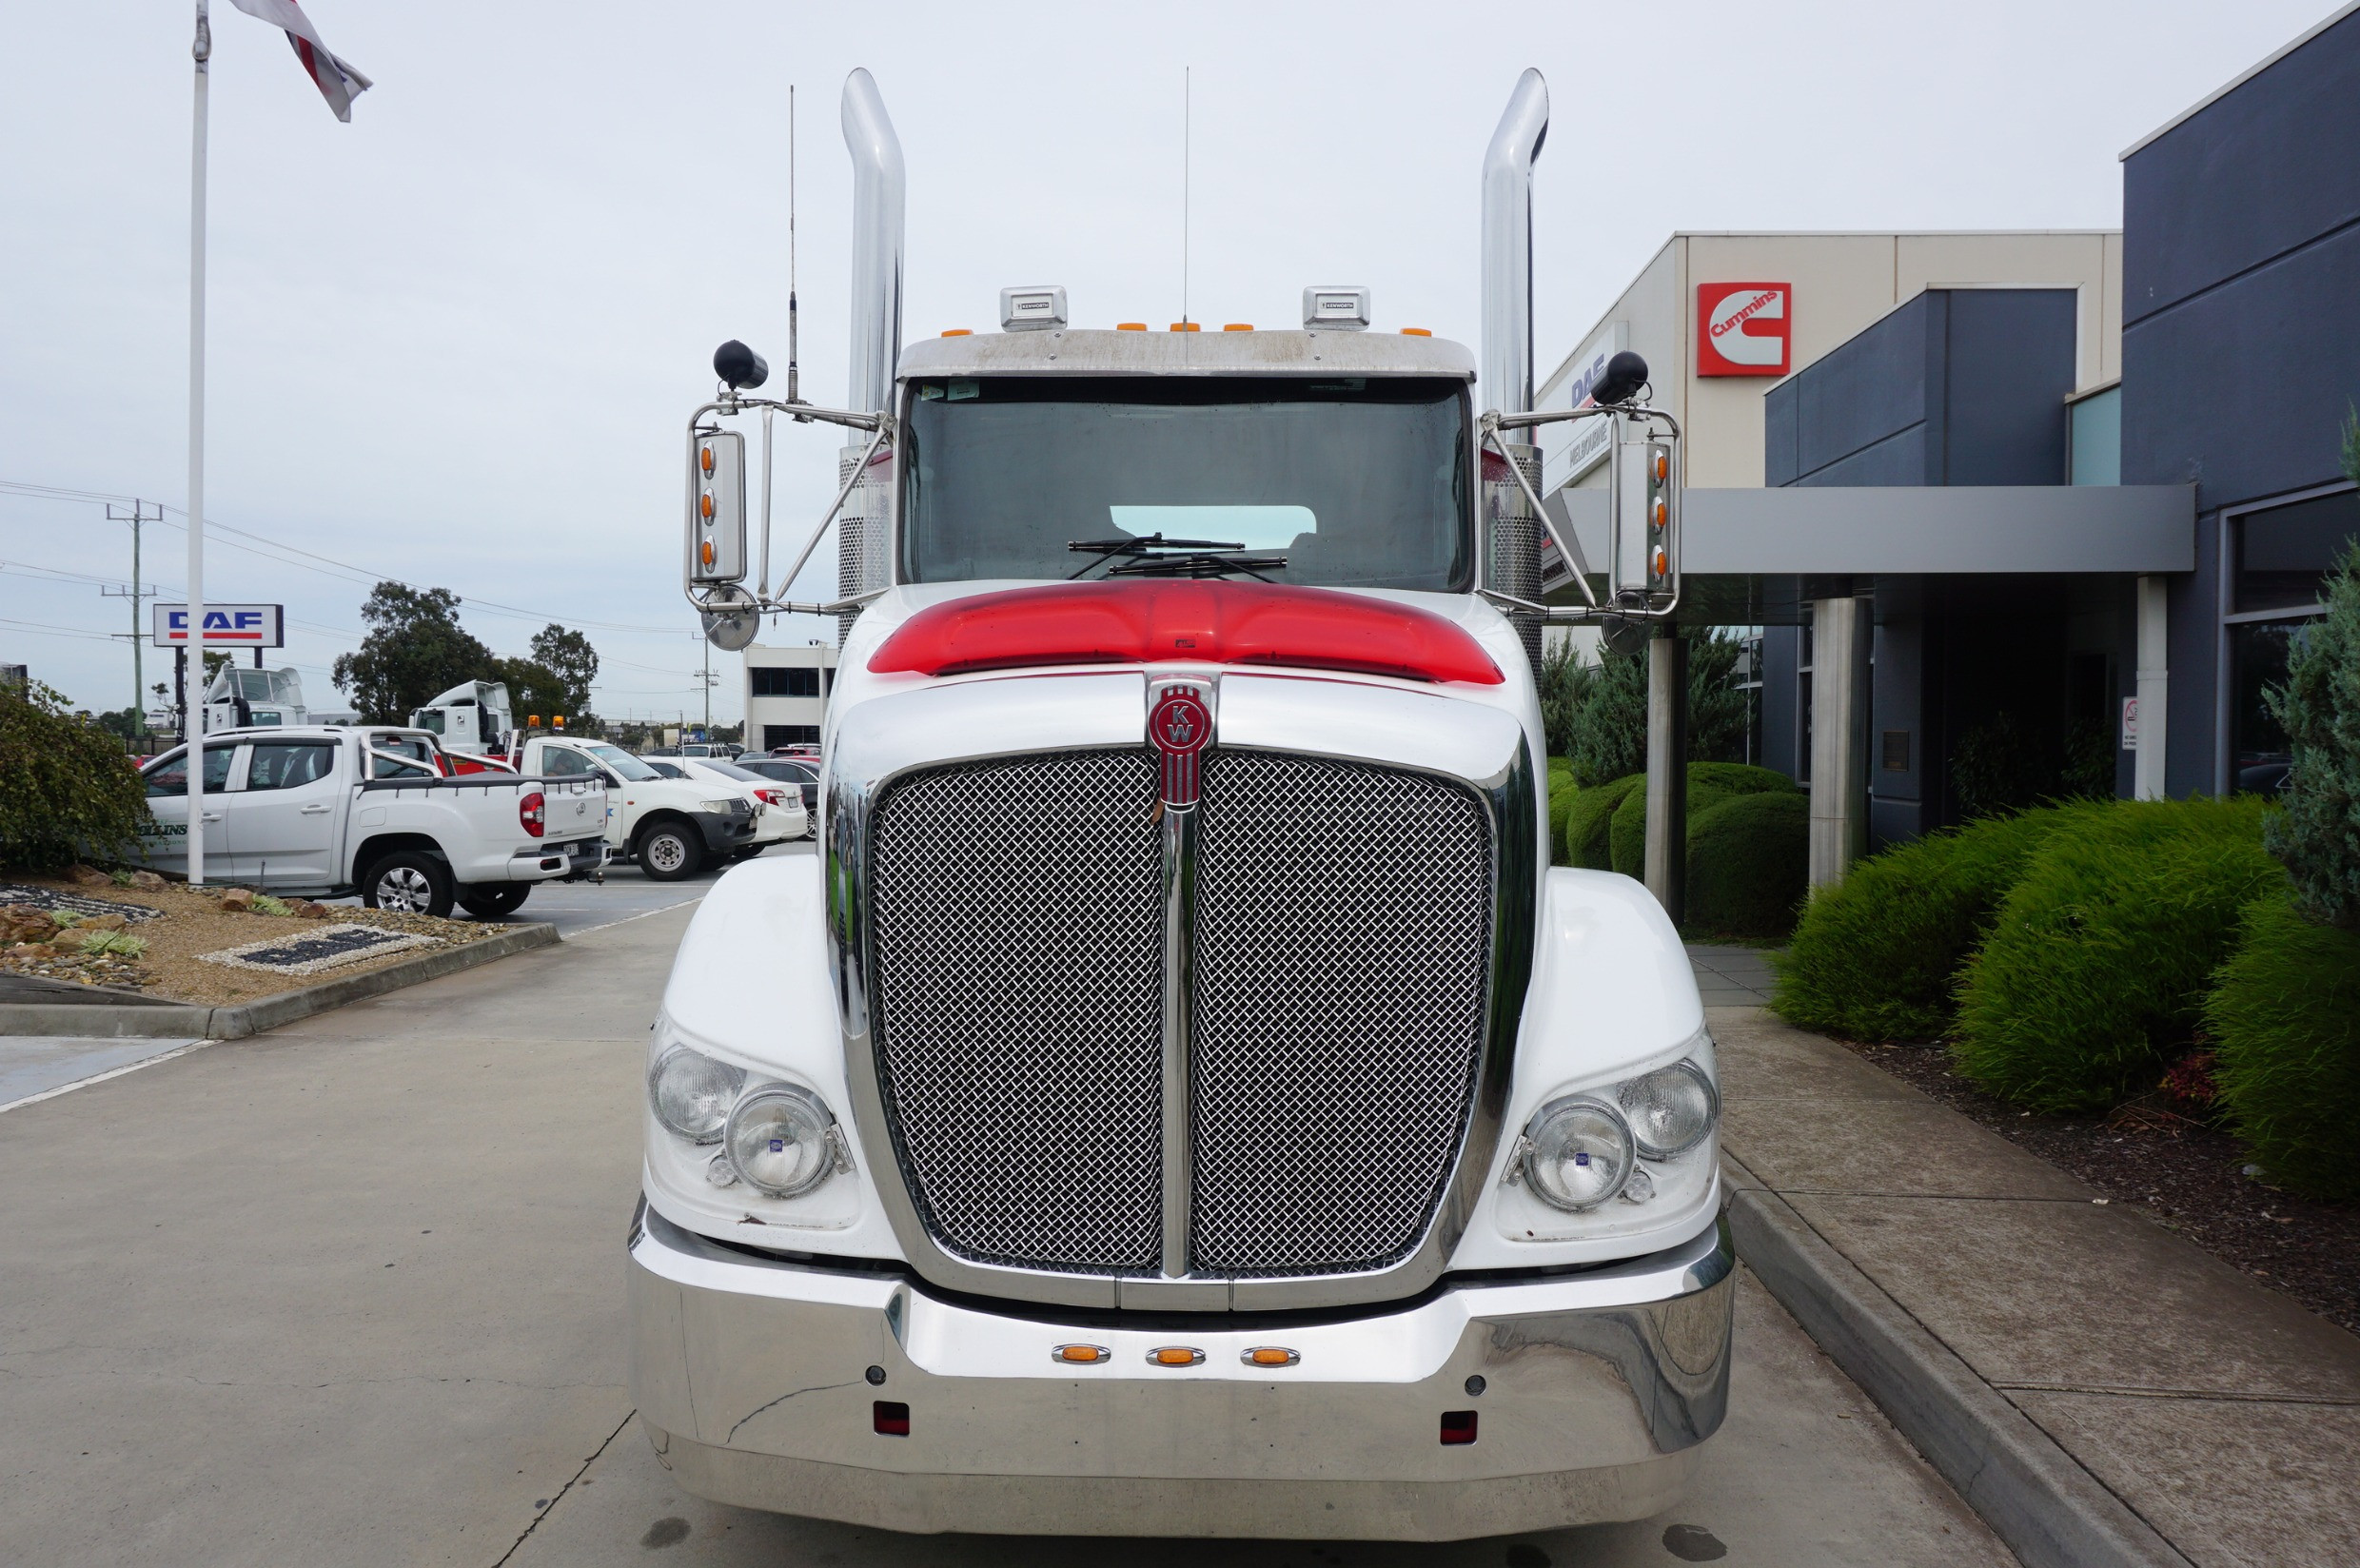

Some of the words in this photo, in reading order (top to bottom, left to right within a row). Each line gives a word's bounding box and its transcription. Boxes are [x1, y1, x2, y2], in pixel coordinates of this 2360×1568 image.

[1710, 291, 1778, 338] Cummins
[1569, 420, 1607, 468] MELBOURNE
[168, 612, 263, 629] DAF
